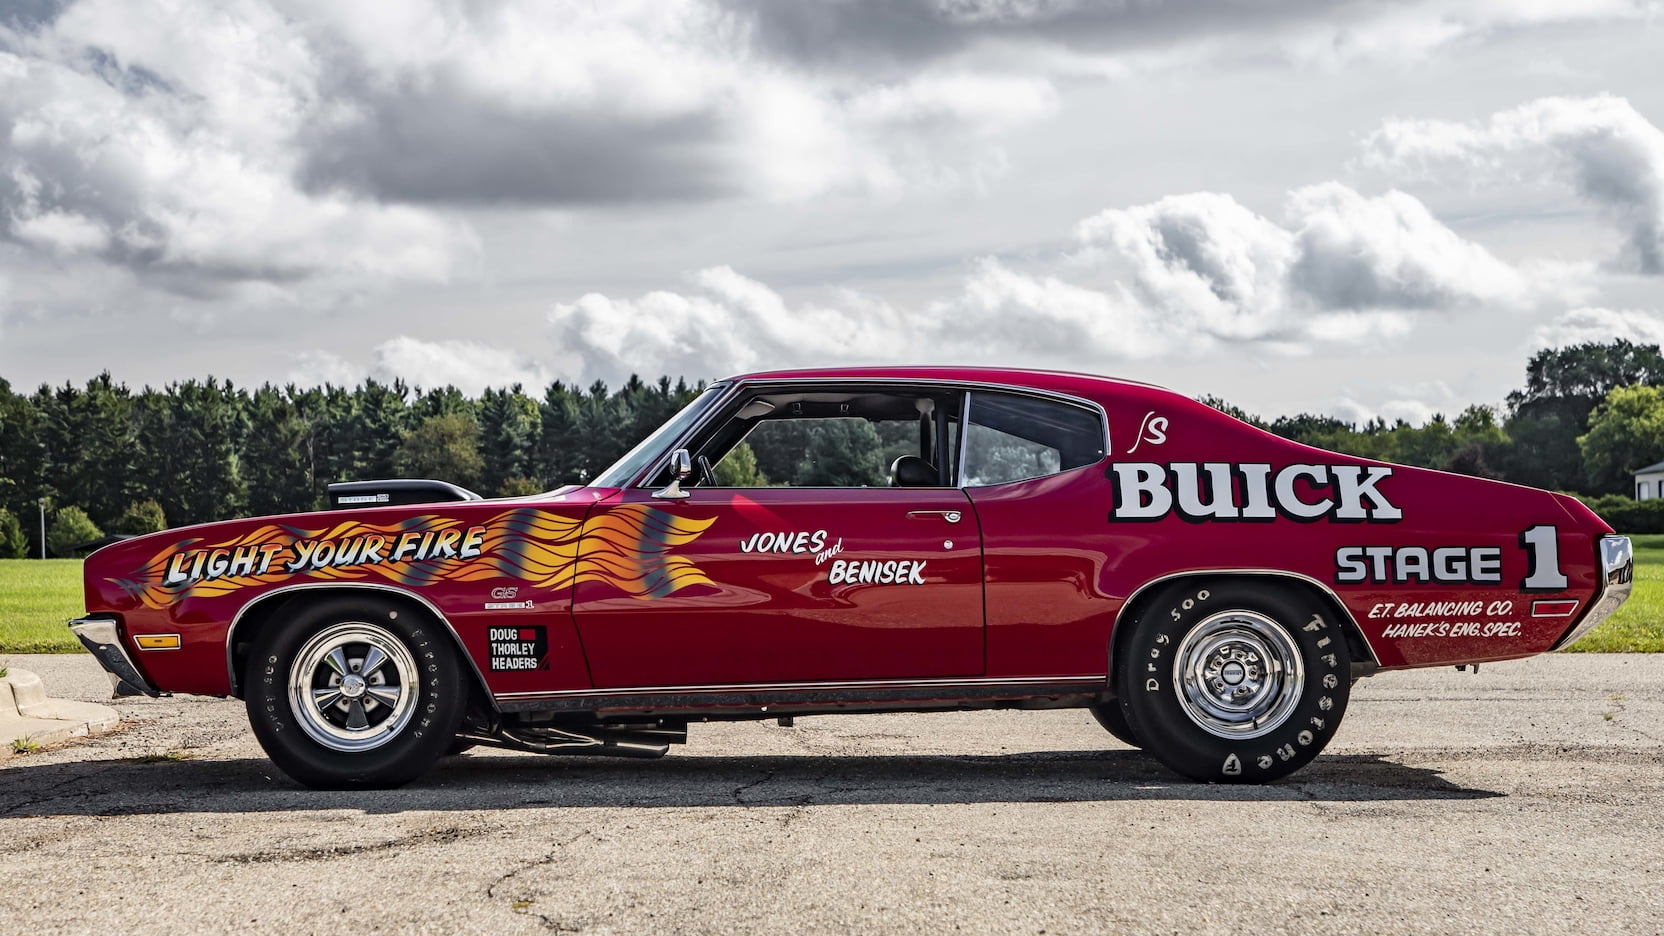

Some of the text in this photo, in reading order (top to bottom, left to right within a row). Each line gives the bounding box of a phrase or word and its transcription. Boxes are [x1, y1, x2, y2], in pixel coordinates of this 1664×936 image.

[1107, 462, 1403, 523] BUICK
[740, 529, 828, 554] JONES
[815, 537, 845, 566] and
[163, 525, 487, 586] LIGHT YOUR FIRE
[1335, 525, 1569, 593] STAGE 1
[829, 559, 927, 585] BENISEK
[1368, 600, 1513, 619] E.T. BALANCING CO.
[490, 628, 518, 641] DOUG
[1146, 589, 1211, 692] Drag 500
[1381, 620, 1450, 638] HANEK'S
[491, 643, 535, 655] THORLEY
[492, 657, 538, 670] HEADERS
[1257, 613, 1339, 770] Firestone
